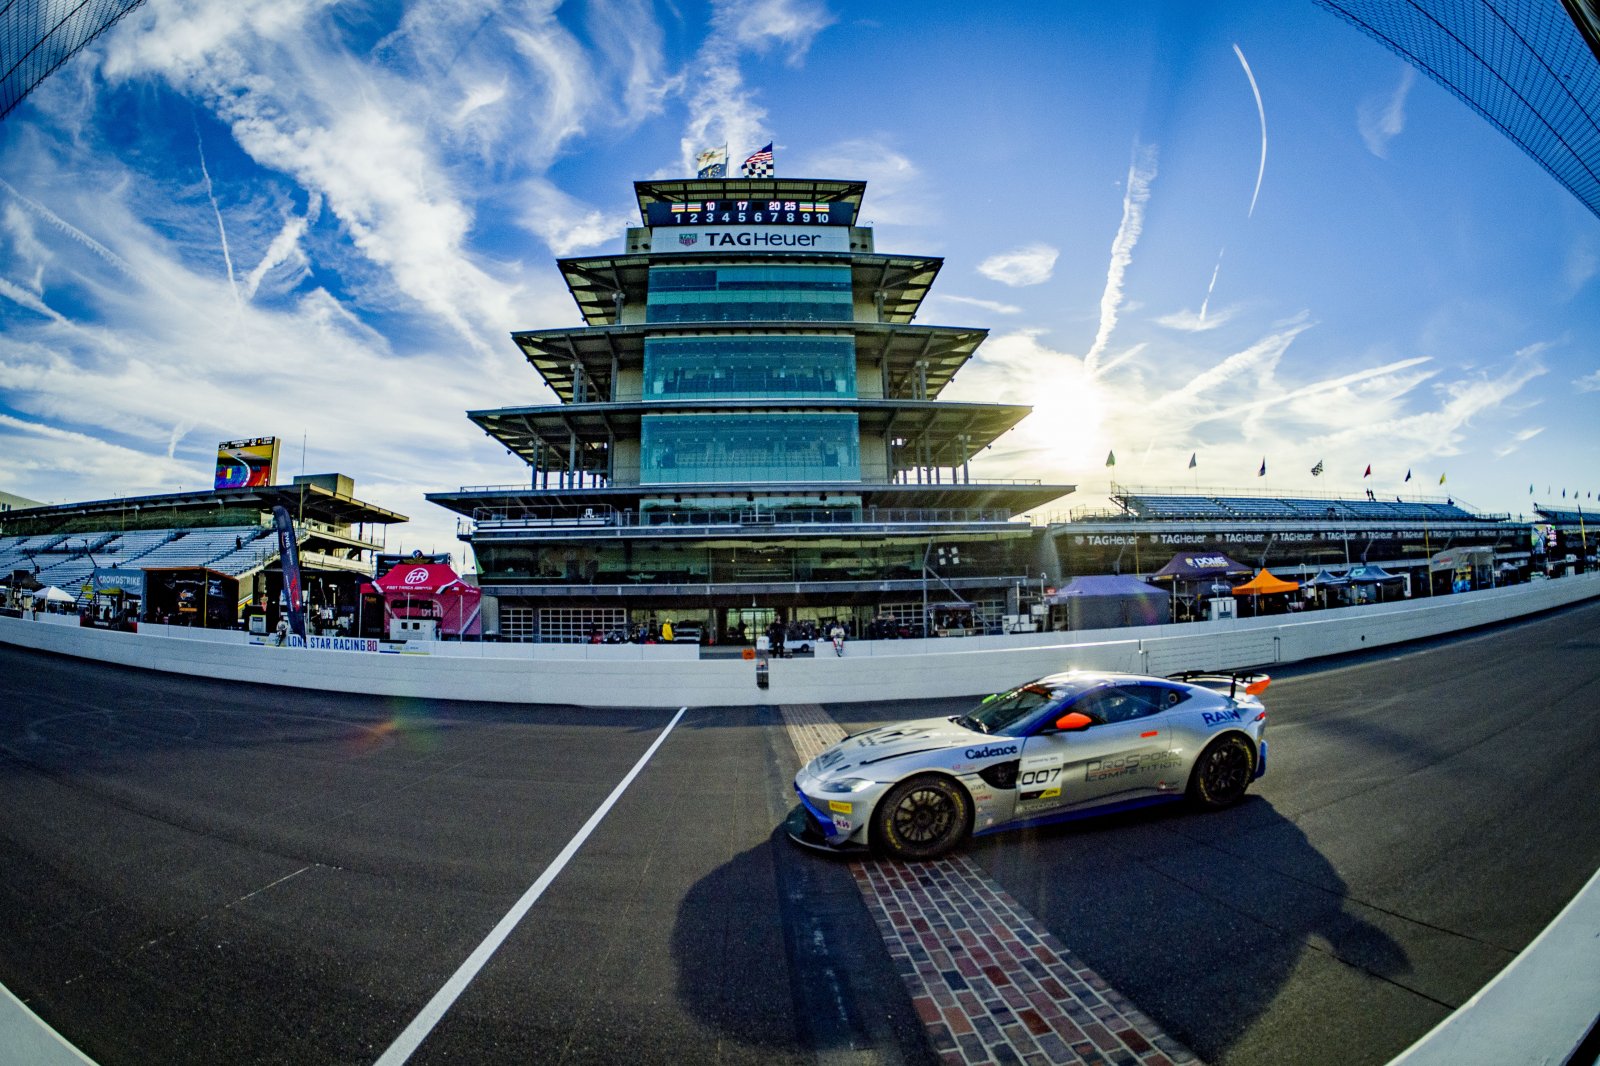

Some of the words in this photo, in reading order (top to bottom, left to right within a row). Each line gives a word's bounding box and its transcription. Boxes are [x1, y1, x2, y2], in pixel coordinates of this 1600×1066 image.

[706, 202, 715, 211] 10
[737, 201, 748, 211] 17
[768, 202, 780, 211] 20
[784, 202, 796, 211] 25
[675, 214, 681, 223] 1
[690, 214, 697, 223] 2
[706, 213, 715, 222] 3
[722, 213, 730, 222] 4
[738, 213, 746, 222] 5
[754, 213, 762, 222] 6
[770, 213, 778, 222] 7
[786, 213, 795, 222] 8
[802, 213, 811, 222] 9
[816, 213, 829, 223] 10
[1195, 557, 1227, 567] DOME
[98, 575, 141, 586] CROWDSTRIKE
[287, 635, 308, 649] LON
[310, 637, 331, 649] STAR
[333, 638, 366, 652] RACING
[366, 640, 378, 652] 80
[1201, 710, 1241, 724] RAIN
[964, 745, 1018, 760] Cadence
[1021, 767, 1062, 786] 007
